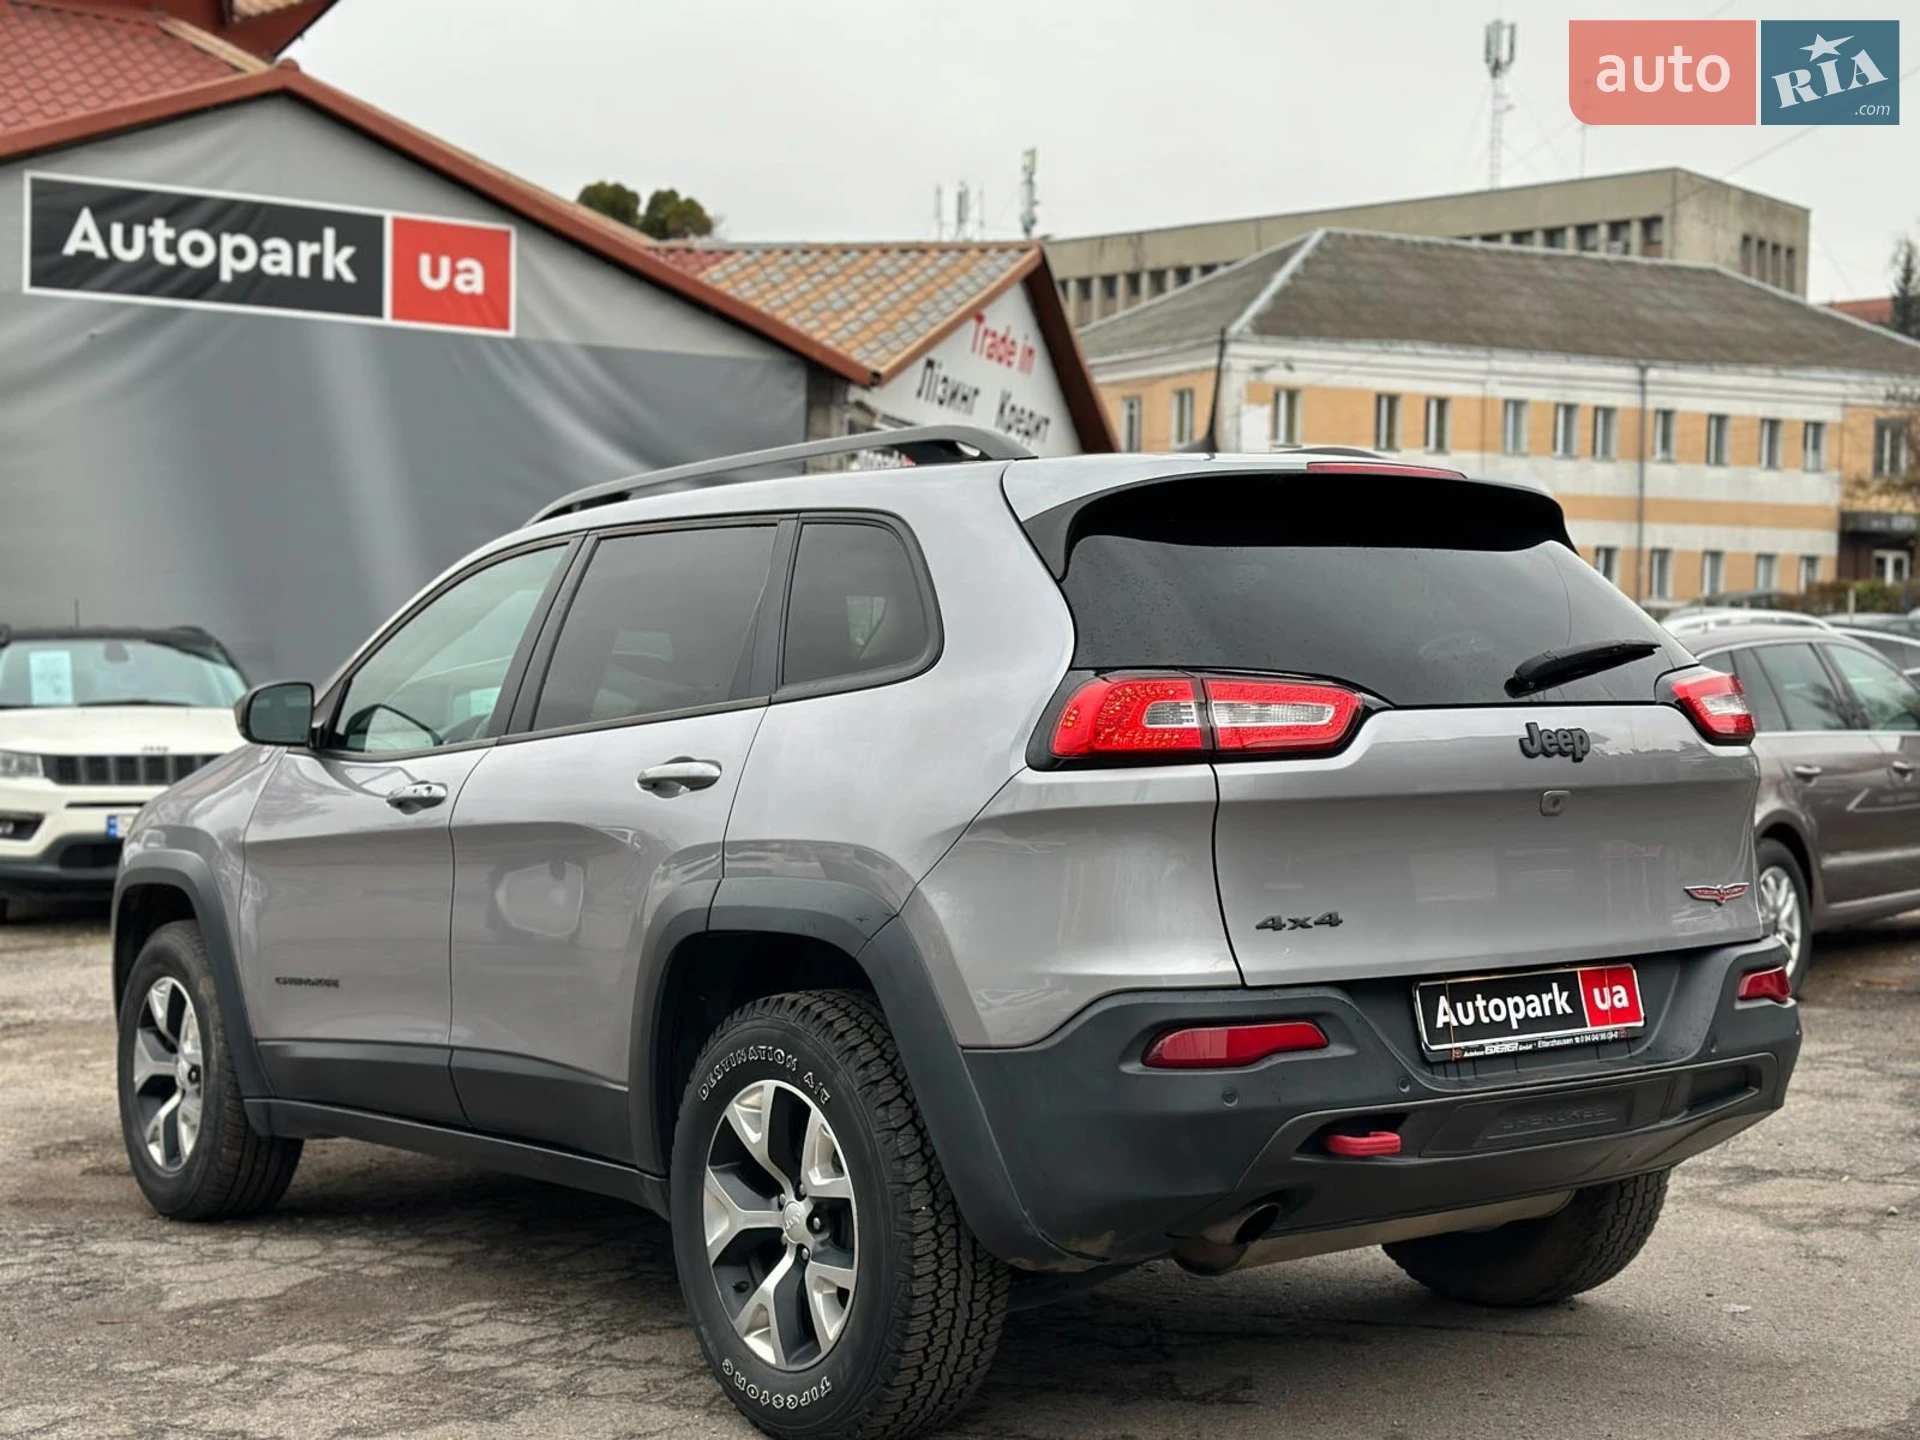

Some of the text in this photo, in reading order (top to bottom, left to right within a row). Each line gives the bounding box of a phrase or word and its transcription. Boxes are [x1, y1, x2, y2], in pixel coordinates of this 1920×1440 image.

[62, 206, 485, 295] Autopark ua
[971, 312, 1036, 376] Trade in
[916, 357, 980, 417] Лізинг
[994, 388, 1051, 446] Кредит
[1518, 721, 1591, 763] Jeep
[1255, 911, 1344, 932] 4x4
[1436, 982, 1629, 1030] Autopark ua
[698, 1045, 798, 1101] DESTINATION
